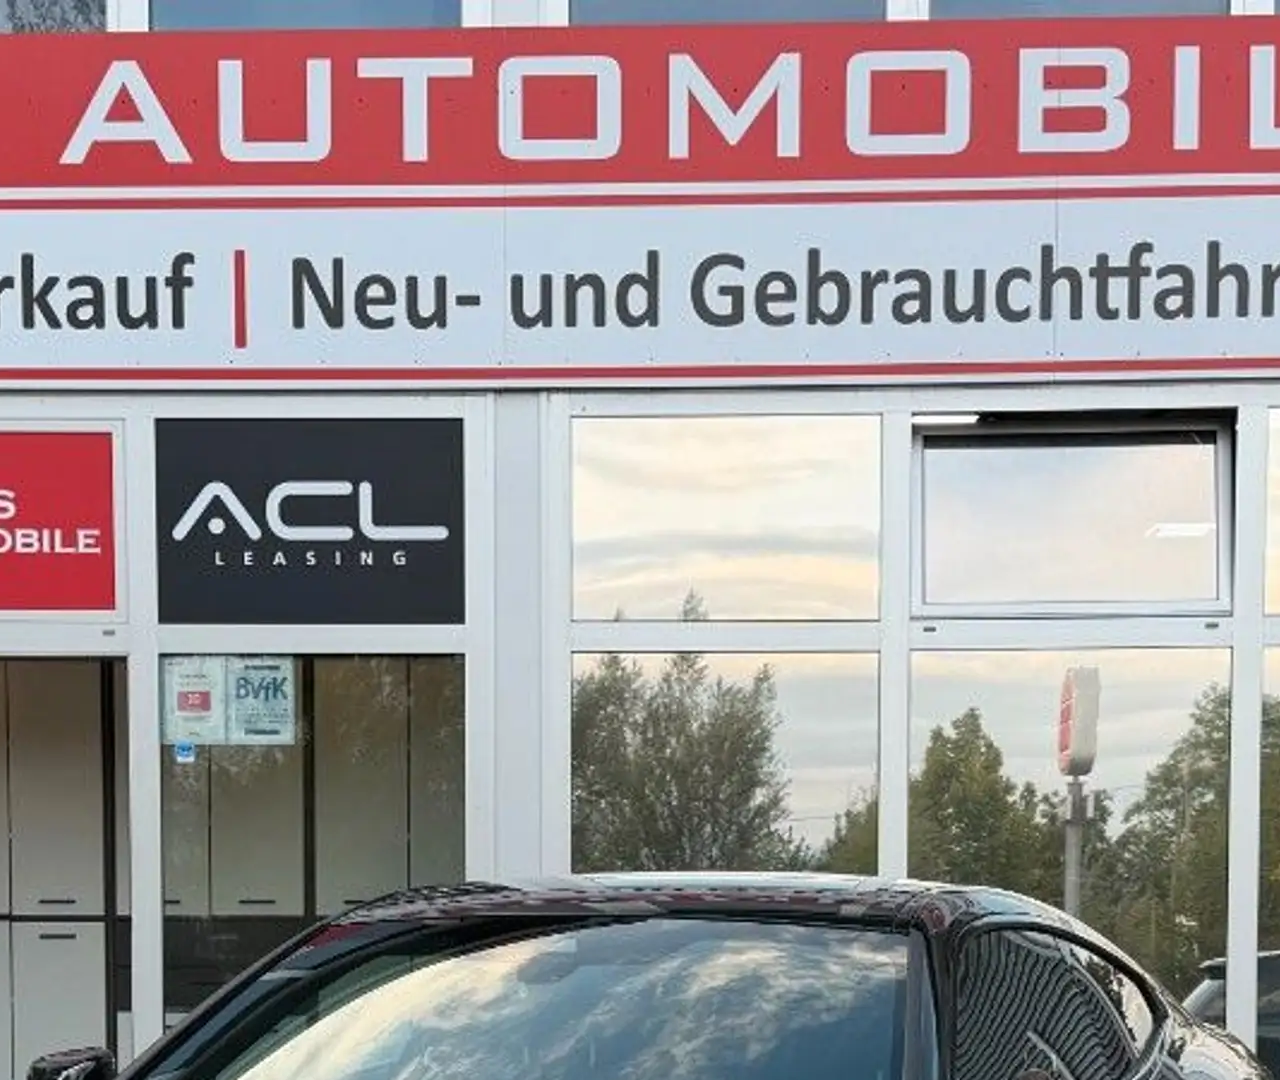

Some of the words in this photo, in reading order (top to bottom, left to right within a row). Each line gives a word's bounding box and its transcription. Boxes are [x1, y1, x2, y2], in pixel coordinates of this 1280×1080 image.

[290, 255, 482, 330] Neu-
[510, 249, 660, 328] und
[172, 480, 449, 541] ACL
[215, 550, 407, 566] LEASING
